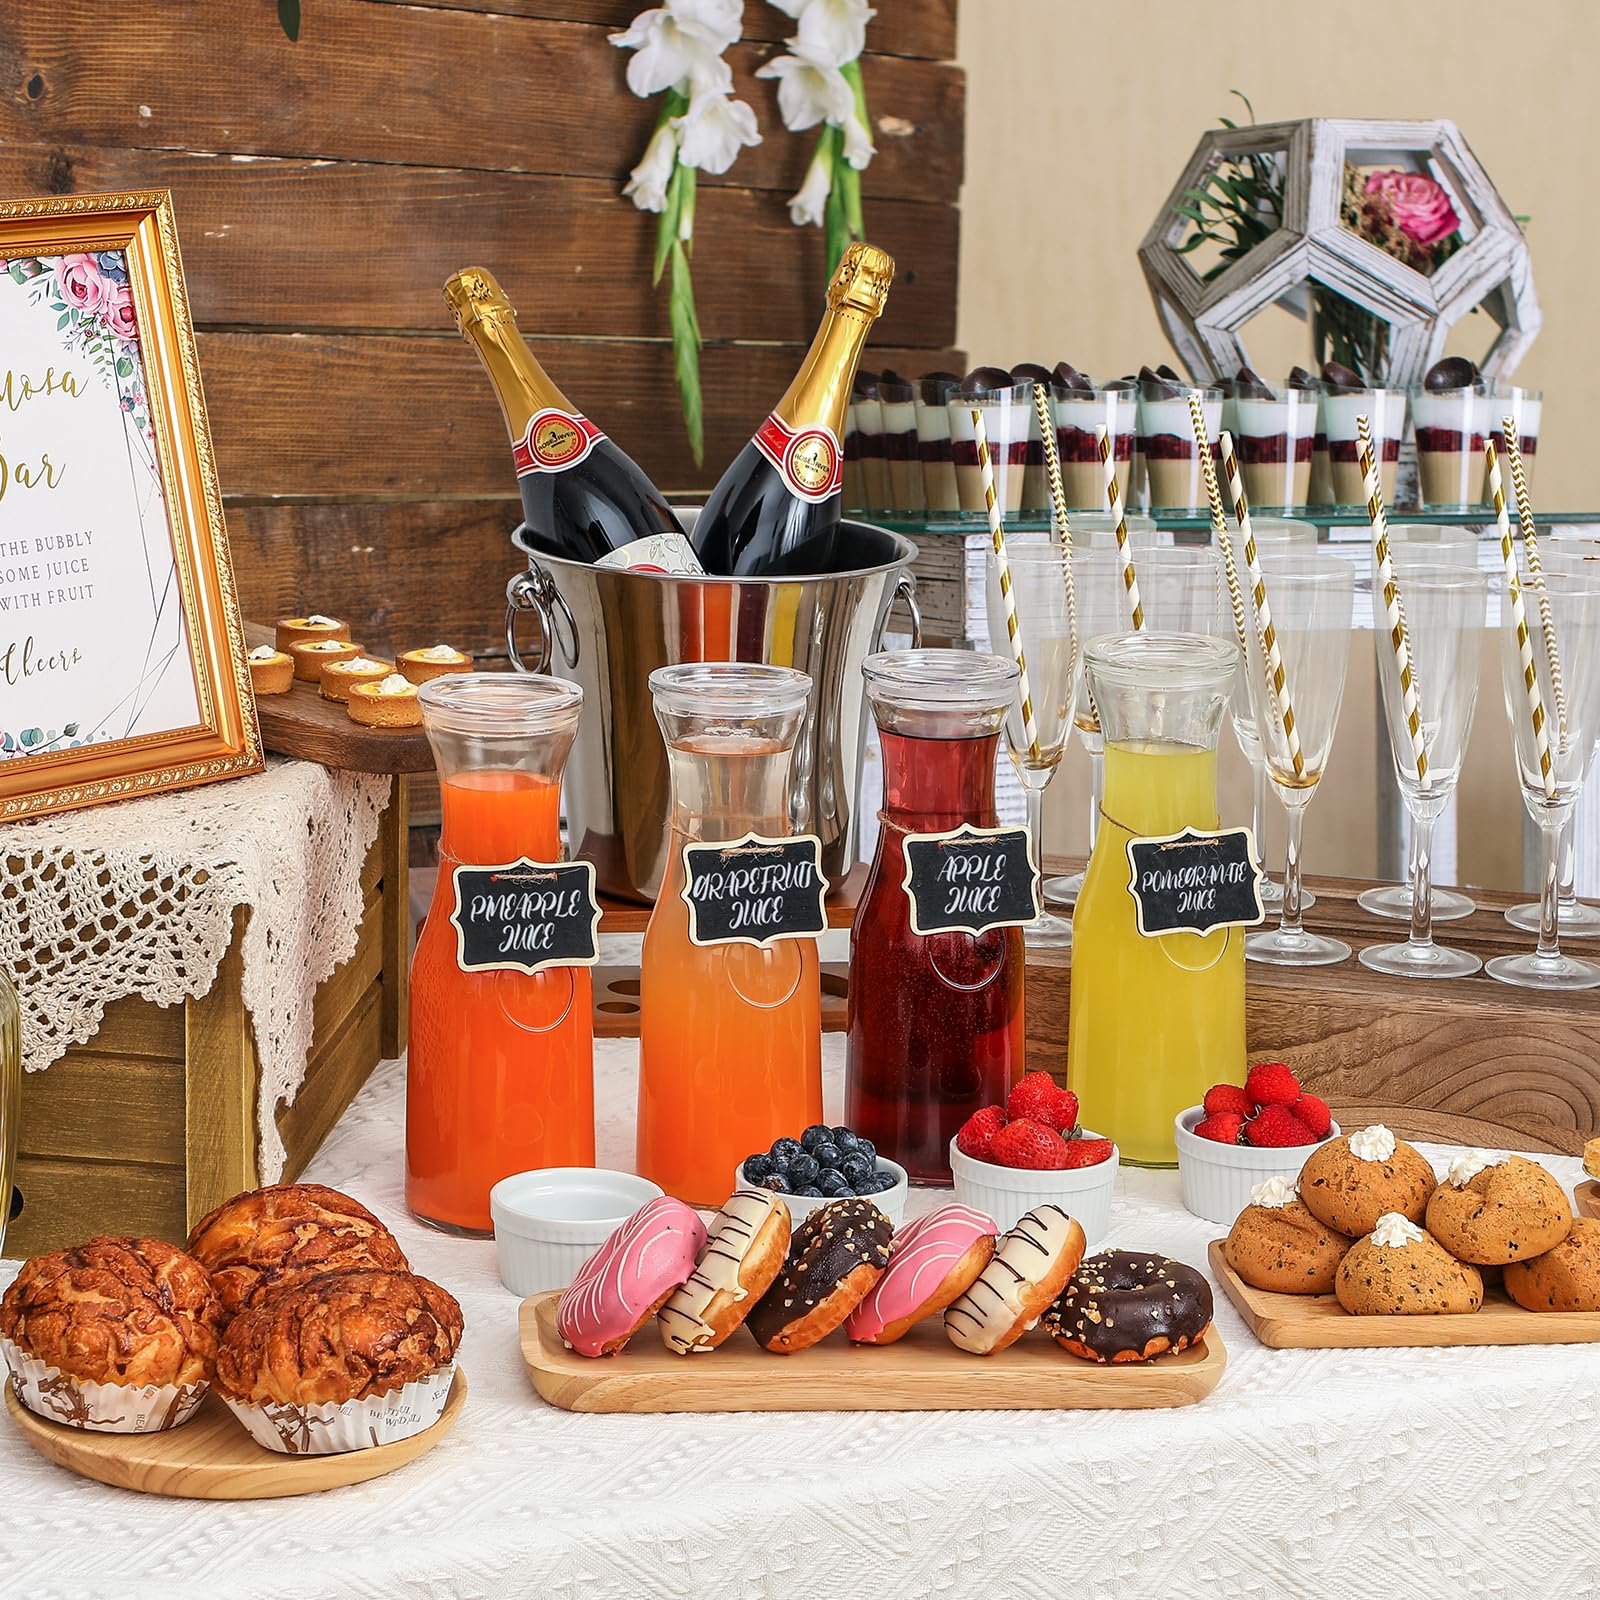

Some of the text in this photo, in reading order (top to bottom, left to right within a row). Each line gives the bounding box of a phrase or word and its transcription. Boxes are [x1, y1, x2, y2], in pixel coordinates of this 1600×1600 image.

[557, 431, 576, 441] RIVER
[0, 531, 93, 558] THE BUBBLY
[0, 558, 90, 585] SOME JUICE
[0, 584, 94, 611] WITH FRUIT
[692, 861, 816, 902] GRAPEFRUIT
[936, 854, 1007, 883] APPLE
[1142, 861, 1248, 893] POMEGRANATE
[470, 889, 582, 922] PINEAPPLE
[729, 896, 784, 929] JUICE
[944, 885, 1002, 915] JUICE
[1176, 888, 1217, 913] JUICE
[498, 922, 556, 953] JUICE
